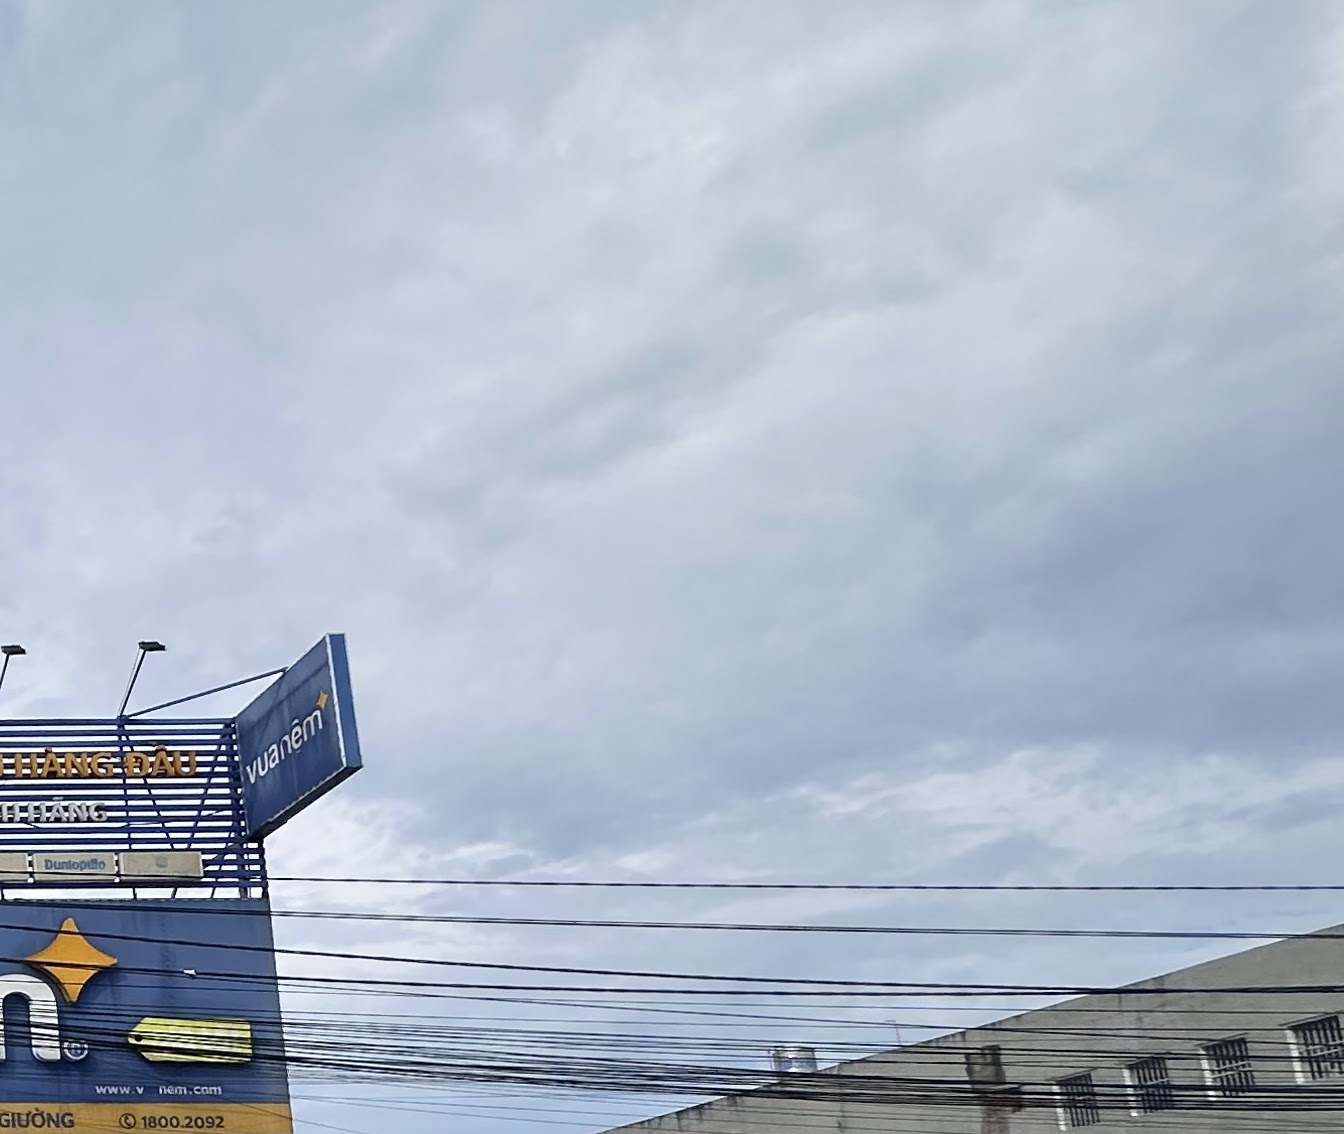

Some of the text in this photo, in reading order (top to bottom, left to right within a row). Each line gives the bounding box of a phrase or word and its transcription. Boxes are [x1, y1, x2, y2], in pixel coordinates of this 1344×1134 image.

[14, 746, 114, 779] HÀNG
[123, 741, 198, 778] ĐẦU
[246, 708, 323, 785] vuanệm
[28, 796, 108, 823] HÃNG
[141, 1115, 225, 1129] 1800.2092
